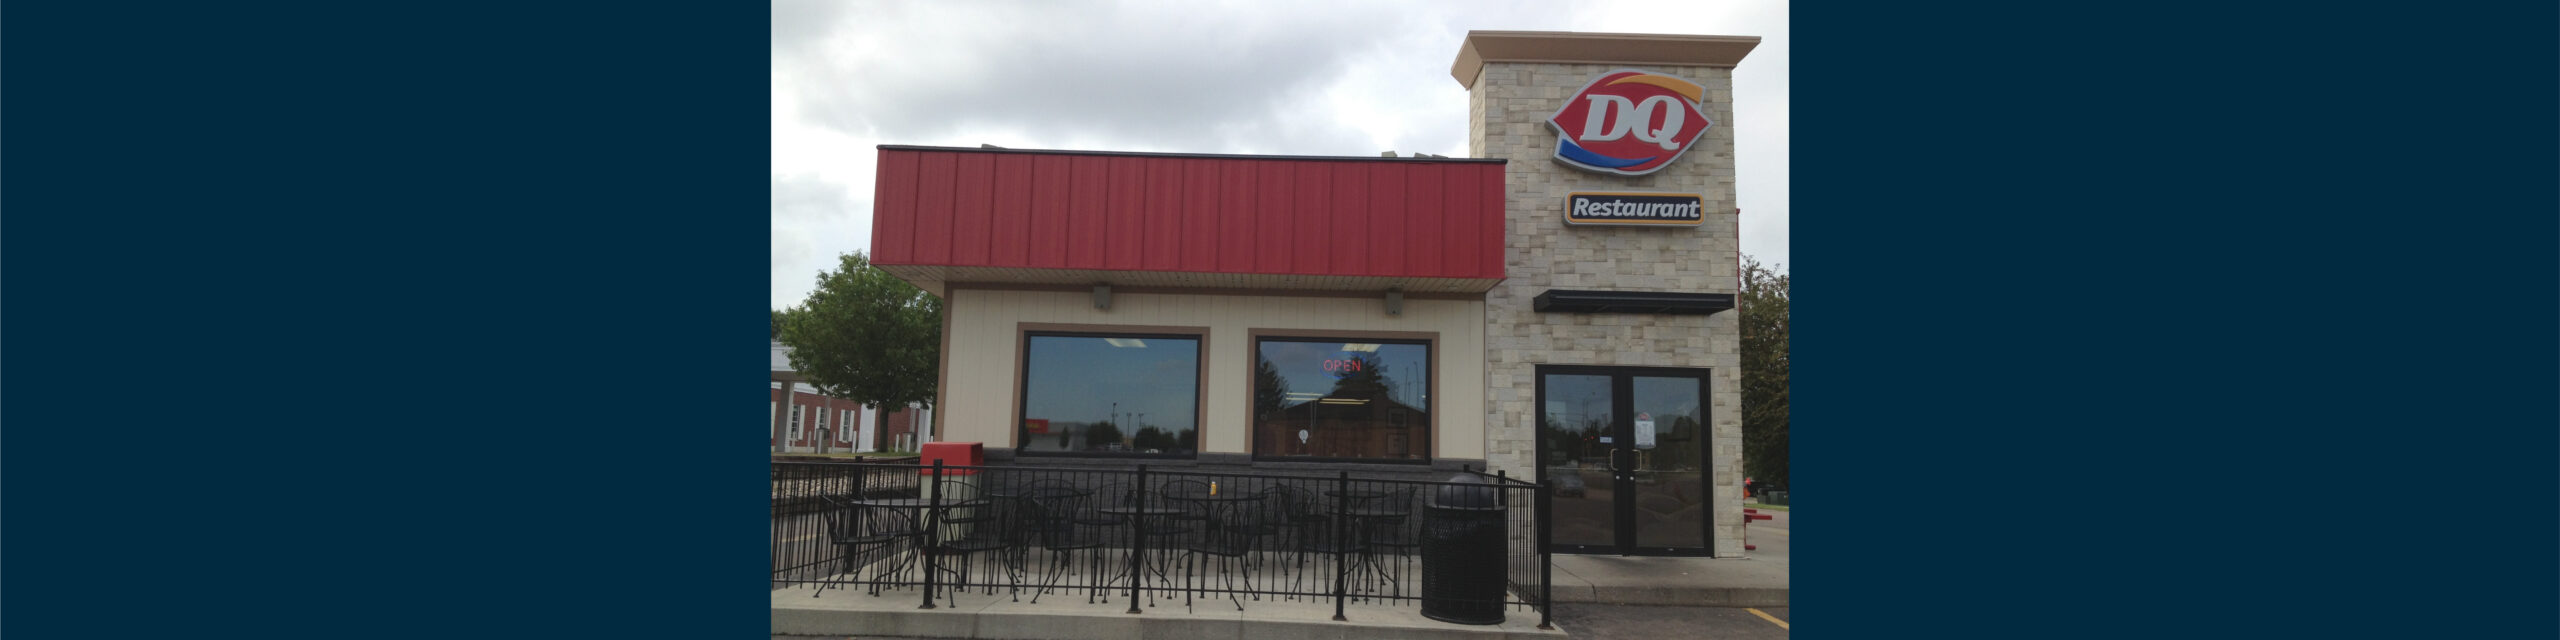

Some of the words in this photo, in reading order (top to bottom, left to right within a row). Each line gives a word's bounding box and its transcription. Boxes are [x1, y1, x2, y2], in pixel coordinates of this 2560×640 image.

[1579, 94, 1686, 150] DQ
[1573, 197, 1700, 218] Restaurant
[1323, 359, 1361, 372] OPEN
